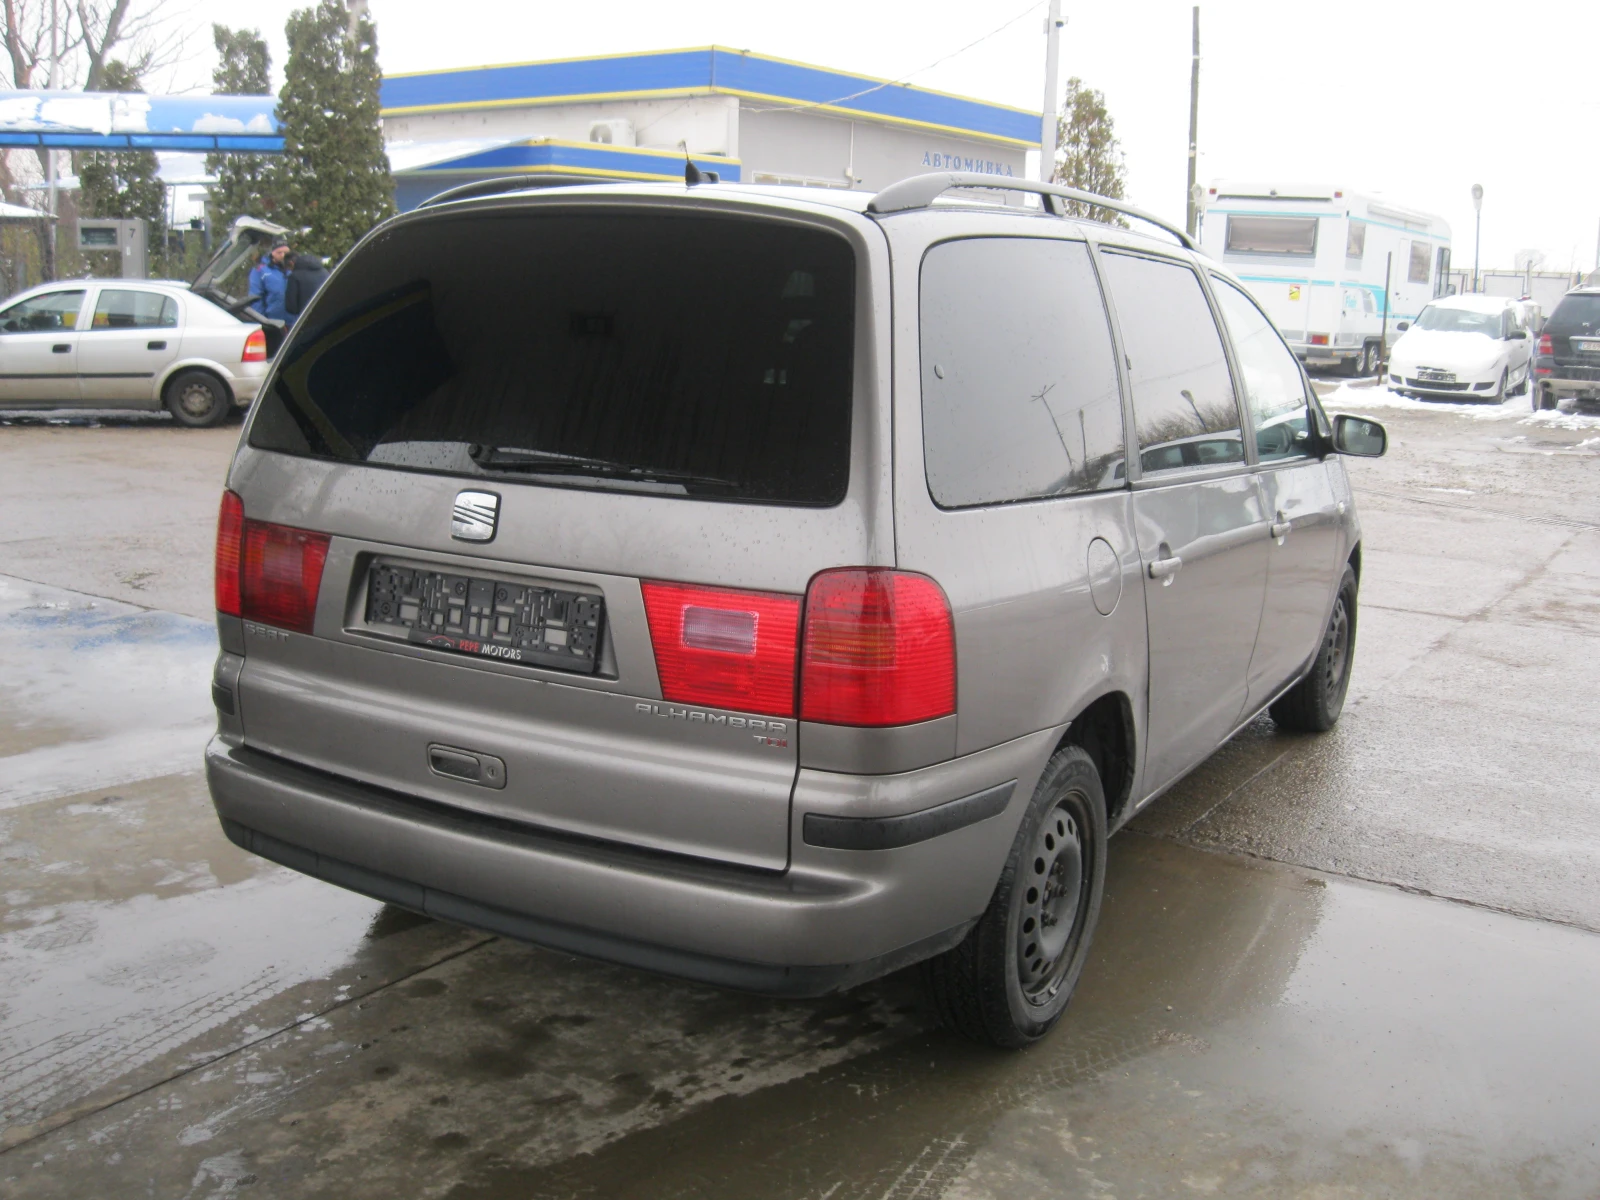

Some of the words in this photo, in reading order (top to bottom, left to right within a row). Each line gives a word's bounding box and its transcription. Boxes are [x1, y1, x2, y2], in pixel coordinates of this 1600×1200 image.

[921, 151, 1014, 177] АВТОМИВКА
[129, 227, 137, 238] 7
[245, 623, 290, 642] SEAT
[459, 639, 480, 653] PEPE
[481, 643, 522, 660] MOTORS
[635, 702, 788, 733] ALHAMBRA
[753, 735, 788, 748] TDI
